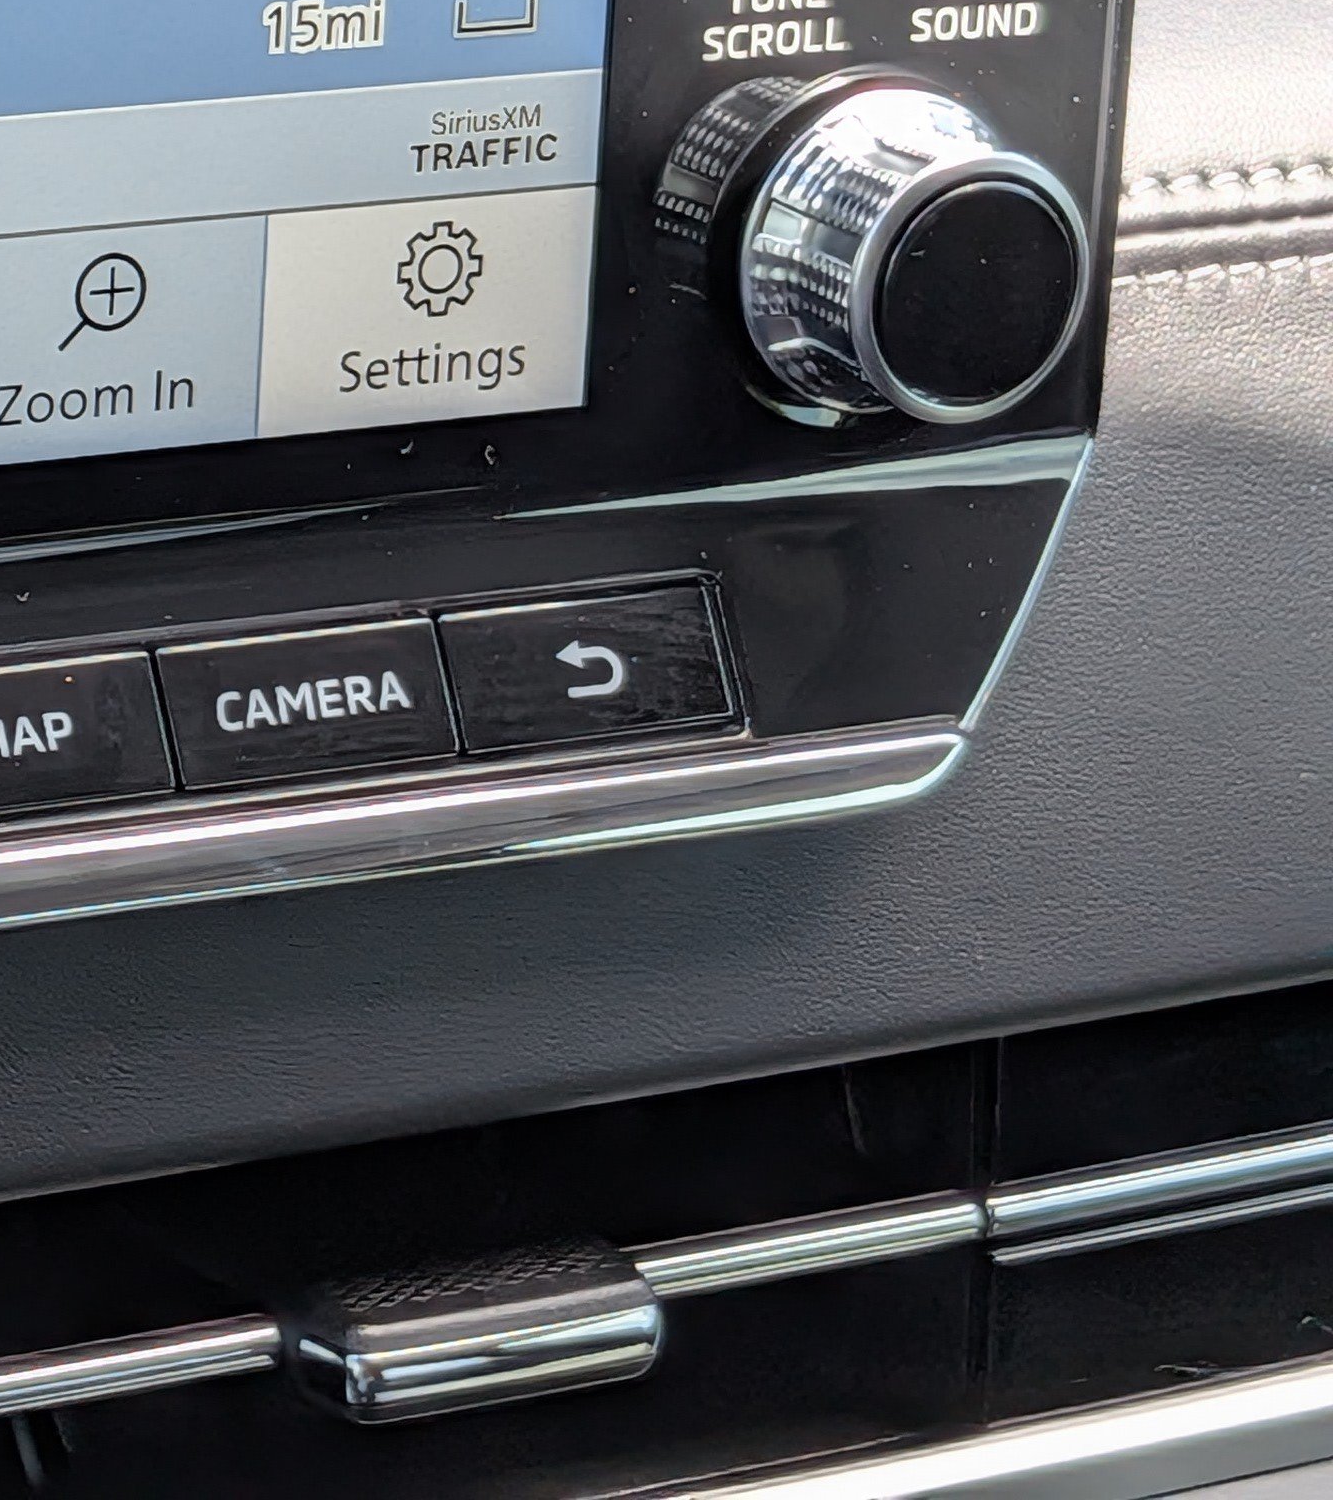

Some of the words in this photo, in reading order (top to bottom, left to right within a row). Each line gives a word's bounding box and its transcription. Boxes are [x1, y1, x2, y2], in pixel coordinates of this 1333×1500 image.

[702, 17, 851, 62] SCROLL
[910, 2, 1040, 43] SOUND
[431, 103, 542, 136] SiriusXM
[410, 133, 559, 173] TRAFFIC
[338, 341, 527, 394] Settings
[153, 369, 195, 411] In
[215, 670, 411, 734] CAMERA
